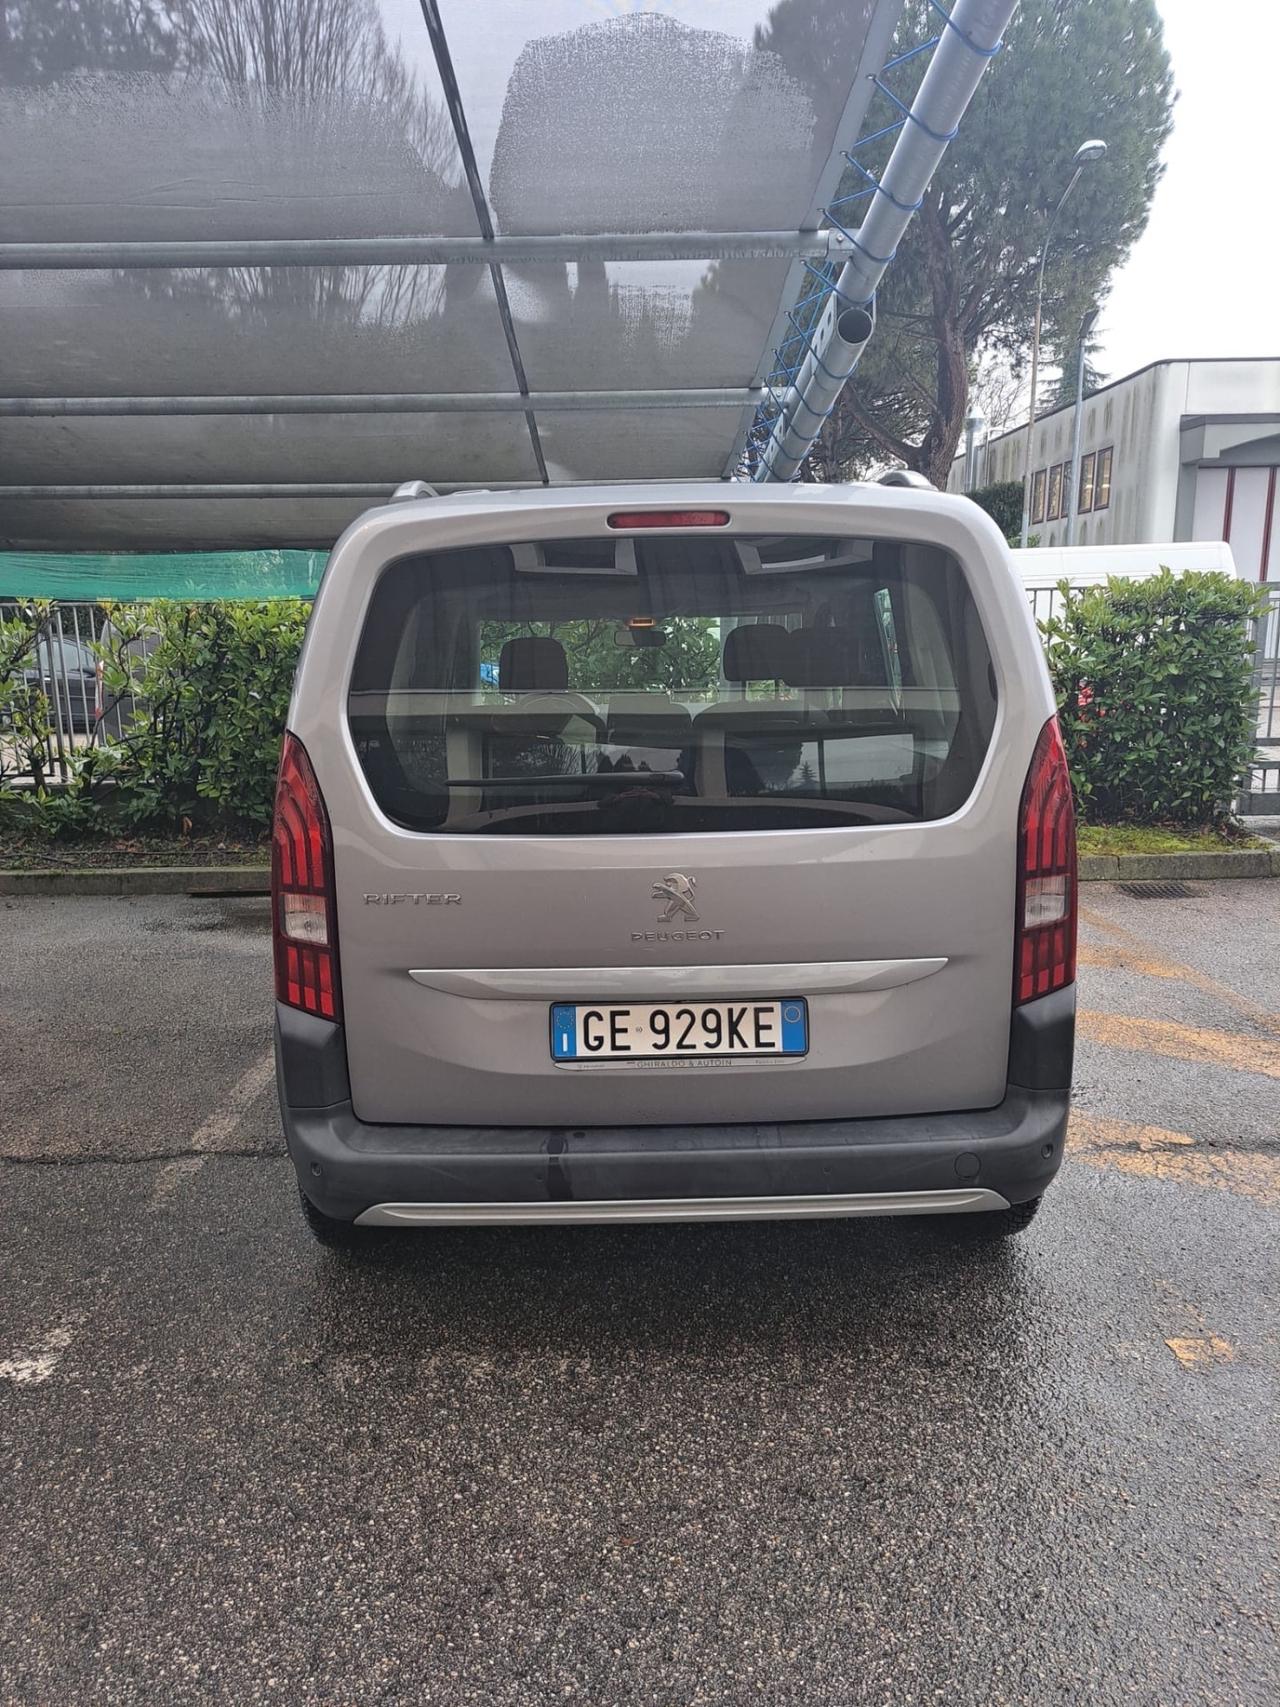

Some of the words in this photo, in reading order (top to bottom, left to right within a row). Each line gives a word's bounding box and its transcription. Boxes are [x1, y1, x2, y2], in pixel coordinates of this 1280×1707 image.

[363, 892, 463, 905] RIFTER
[631, 929, 725, 941] PEUGEOT
[583, 1010, 632, 1051] GE
[649, 1007, 776, 1050] 929KE
